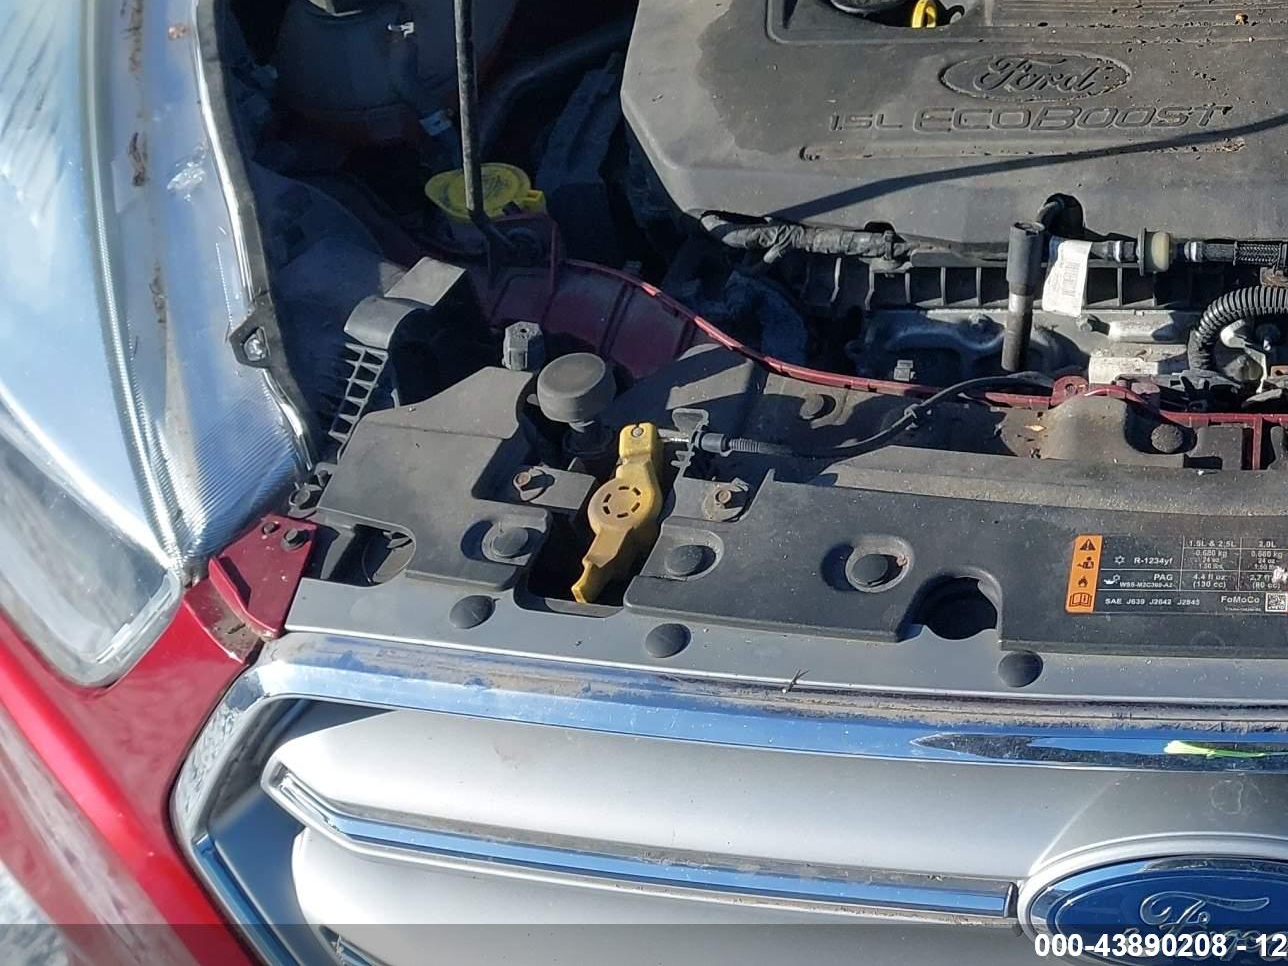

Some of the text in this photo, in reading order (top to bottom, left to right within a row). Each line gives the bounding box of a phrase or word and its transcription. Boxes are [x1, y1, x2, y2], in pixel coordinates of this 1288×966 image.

[972, 56, 1101, 94] Ford
[1133, 556, 1173, 566] R-1234yf
[1153, 573, 1174, 581] PAG
[1104, 597, 1123, 605] SAE
